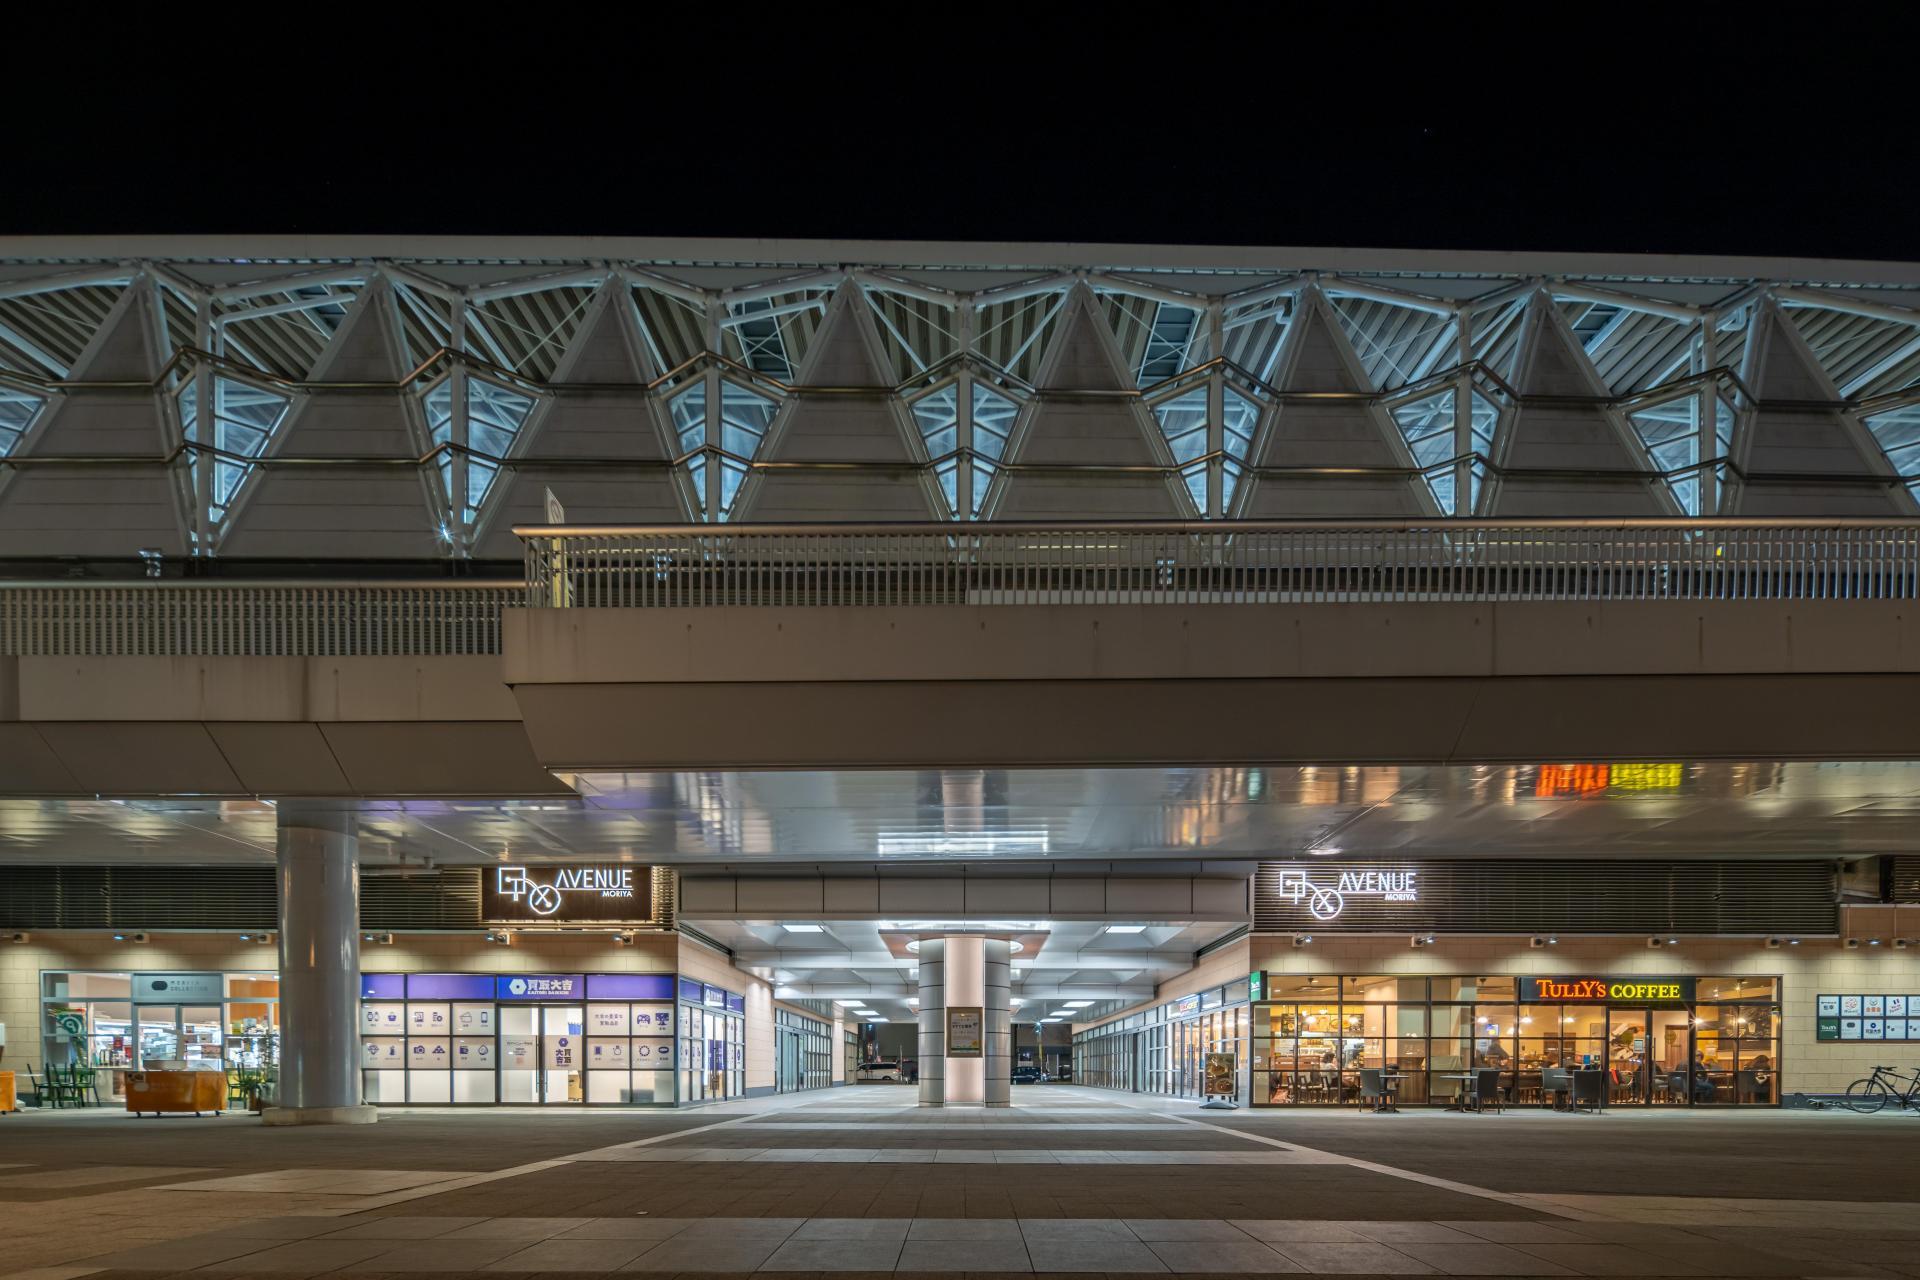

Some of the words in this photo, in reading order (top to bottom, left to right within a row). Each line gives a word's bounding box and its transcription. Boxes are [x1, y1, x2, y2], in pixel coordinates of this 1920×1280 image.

[555, 869, 633, 888] AVENUE
[1337, 872, 1417, 892] AVENUE
[1384, 893, 1416, 901] MORIYA
[1535, 979, 1607, 998] TULLY'S
[1610, 984, 1681, 998] COFFEE
